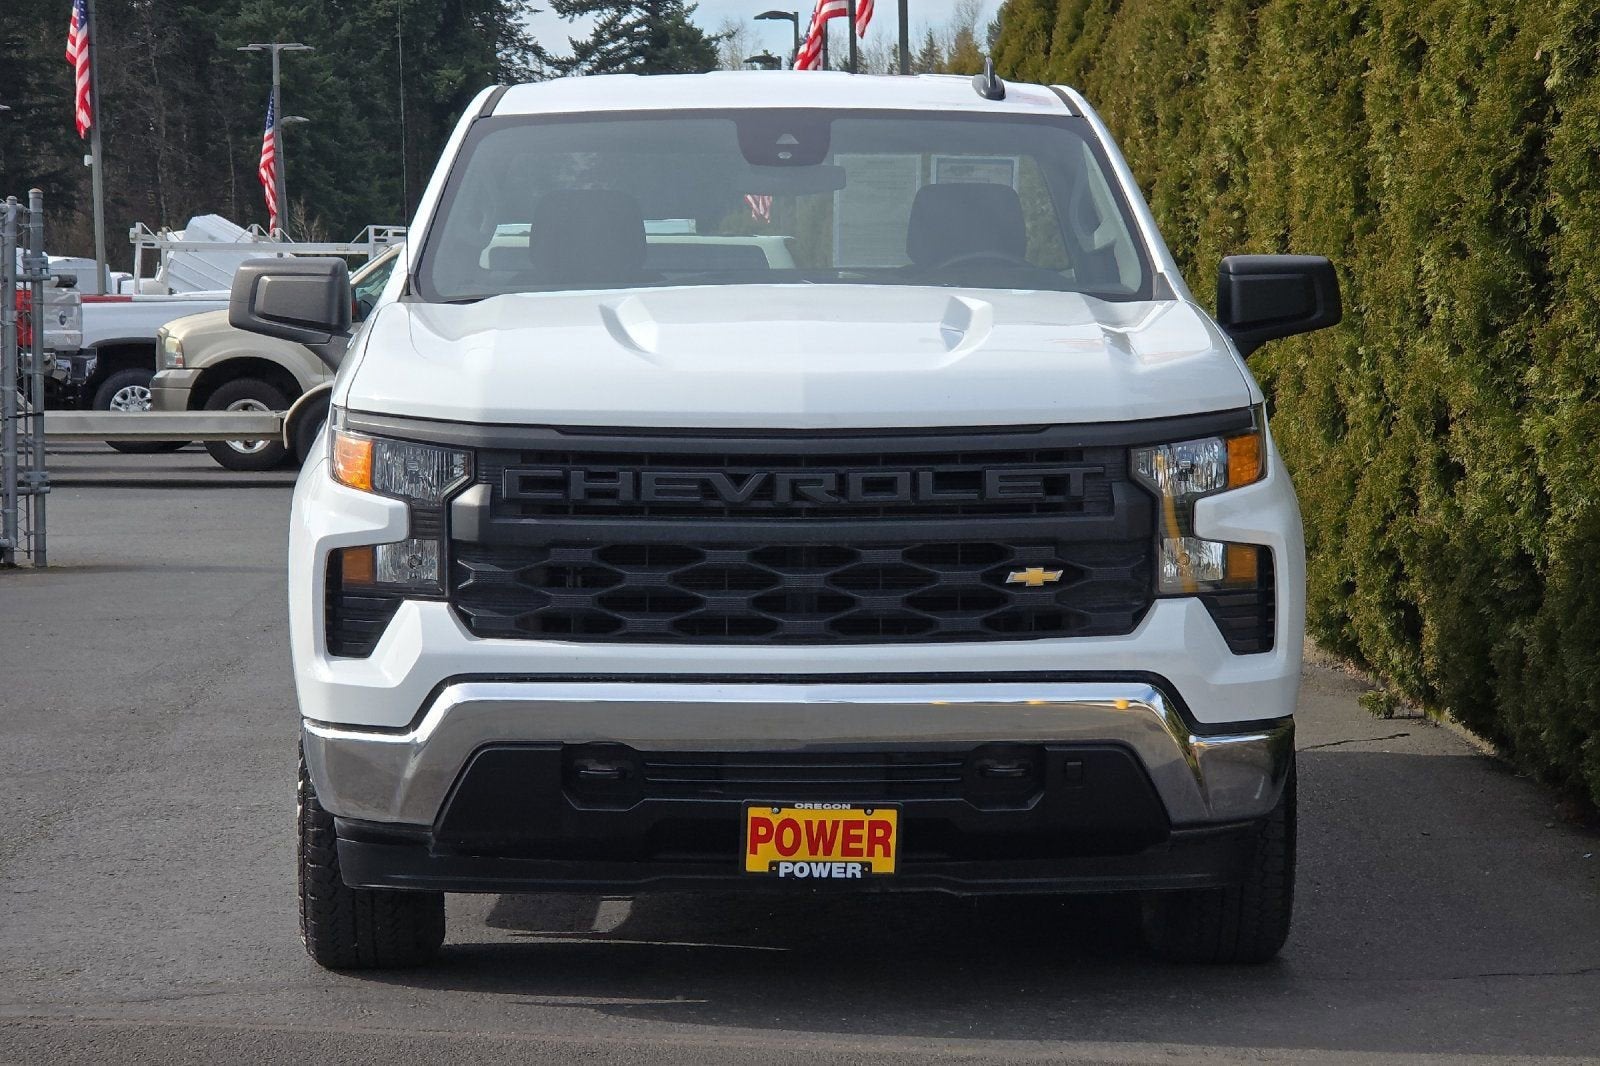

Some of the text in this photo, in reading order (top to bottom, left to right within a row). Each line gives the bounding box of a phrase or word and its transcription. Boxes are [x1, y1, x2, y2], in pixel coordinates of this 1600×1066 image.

[503, 466, 1105, 504] CHEVROLET
[794, 802, 851, 810] OREGON
[749, 816, 893, 858] POWER
[778, 861, 862, 879] POWER
